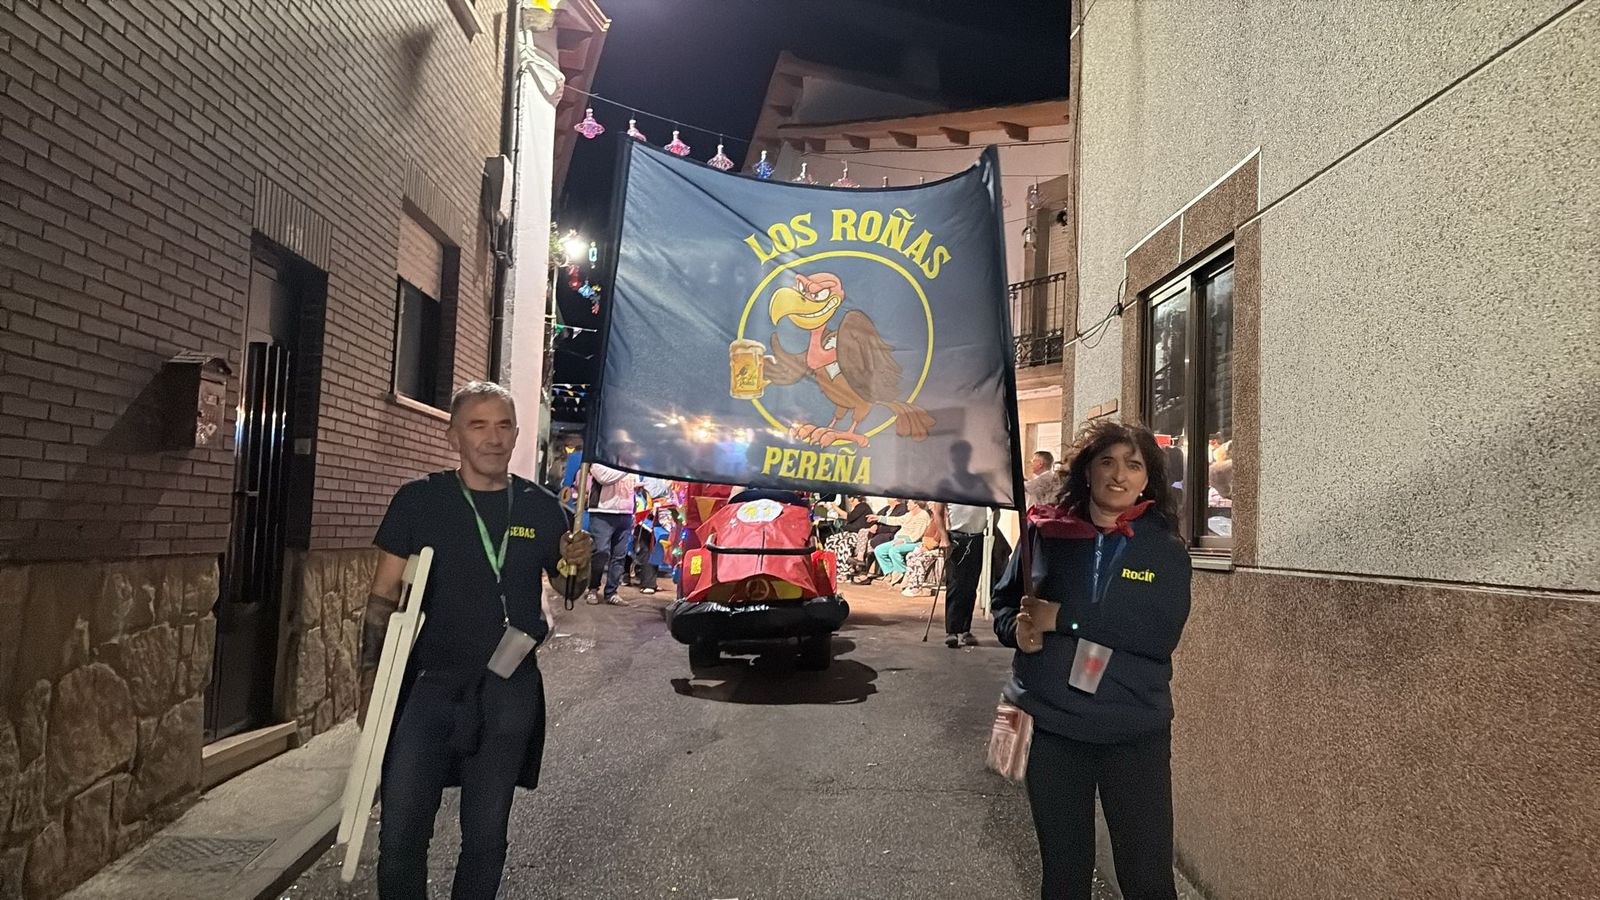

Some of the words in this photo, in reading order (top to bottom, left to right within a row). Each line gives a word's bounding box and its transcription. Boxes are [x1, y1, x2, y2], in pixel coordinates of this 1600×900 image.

[744, 212, 818, 264] LOS
[830, 208, 951, 280] ROÑAS
[761, 446, 872, 485] PEREÑA
